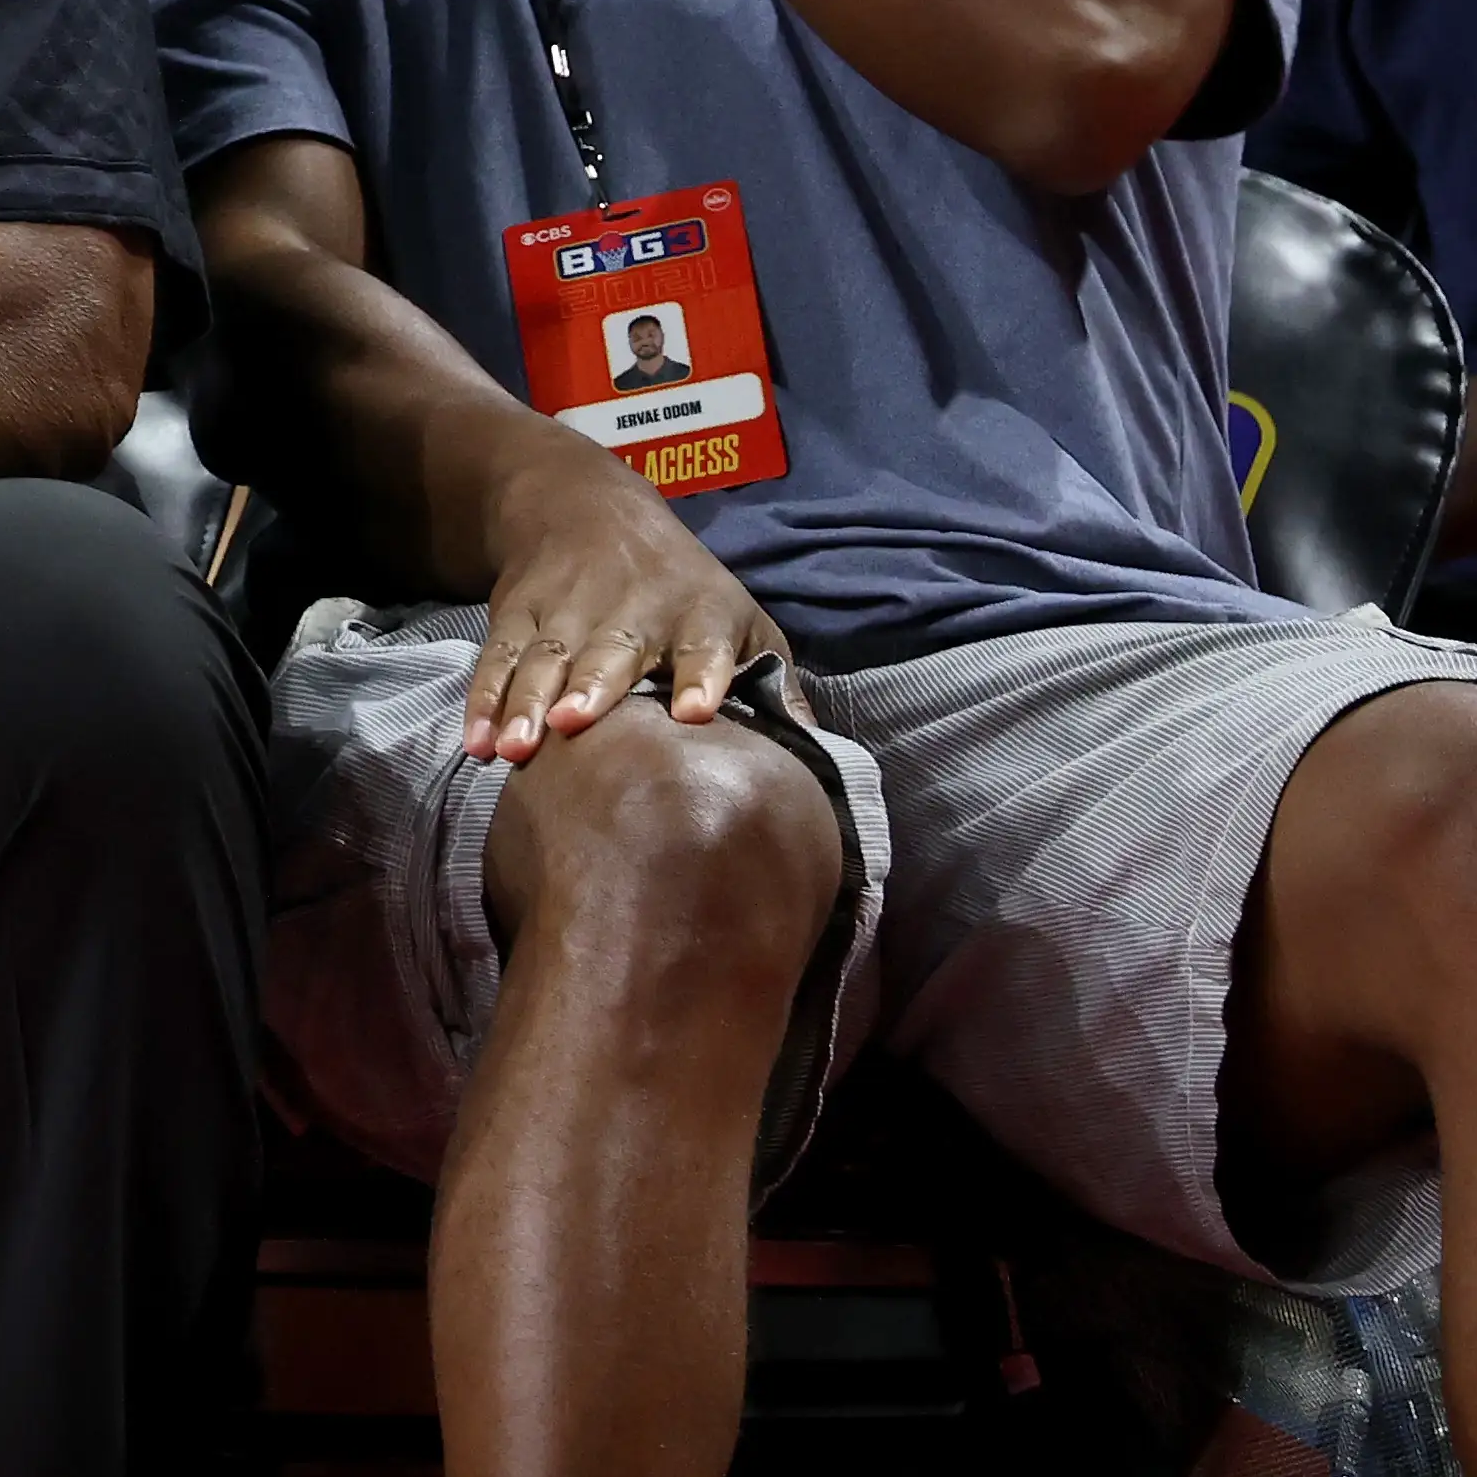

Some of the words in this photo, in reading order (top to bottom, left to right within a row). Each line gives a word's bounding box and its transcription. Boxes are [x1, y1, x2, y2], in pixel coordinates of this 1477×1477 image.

[535, 225, 573, 243] CBS
[557, 256, 717, 320] 2021
[615, 407, 661, 431] JERVAE
[663, 399, 703, 422] ODOM
[643, 434, 740, 487] ACCESS
